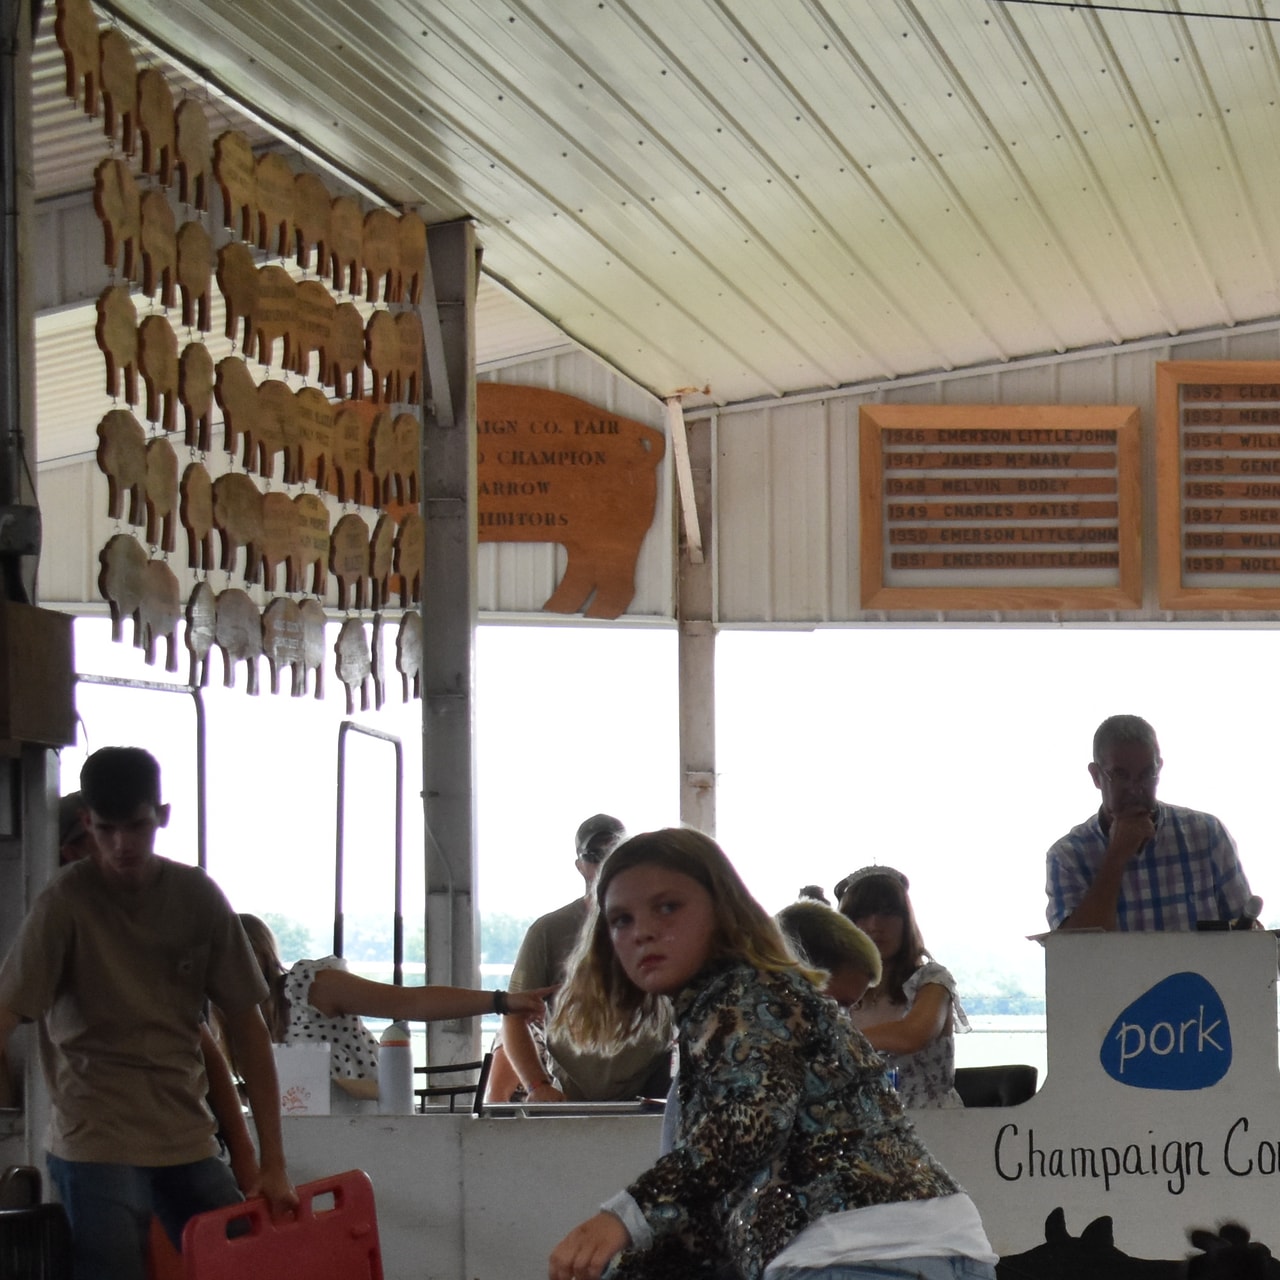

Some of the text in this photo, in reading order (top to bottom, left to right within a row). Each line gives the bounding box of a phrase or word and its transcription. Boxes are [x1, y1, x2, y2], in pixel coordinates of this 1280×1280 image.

[530, 421, 562, 434] CO.
[575, 421, 619, 435] FAIR
[938, 430, 1010, 442] EMERSON
[1018, 430, 1115, 442] LITTLEJOHN
[498, 451, 606, 465] CHAMPION
[1241, 461, 1280, 472] GENE
[480, 482, 550, 495] ARROW
[942, 480, 1000, 492] MELVIN
[1019, 480, 1069, 491] BODEY
[1187, 509, 1223, 521] 1957
[1187, 534, 1224, 546] 1958
[1187, 559, 1224, 570] 1959
[1241, 559, 1280, 571] NOEL
[1115, 1004, 1224, 1074] pork
[994, 1123, 1210, 1195] Champaign
